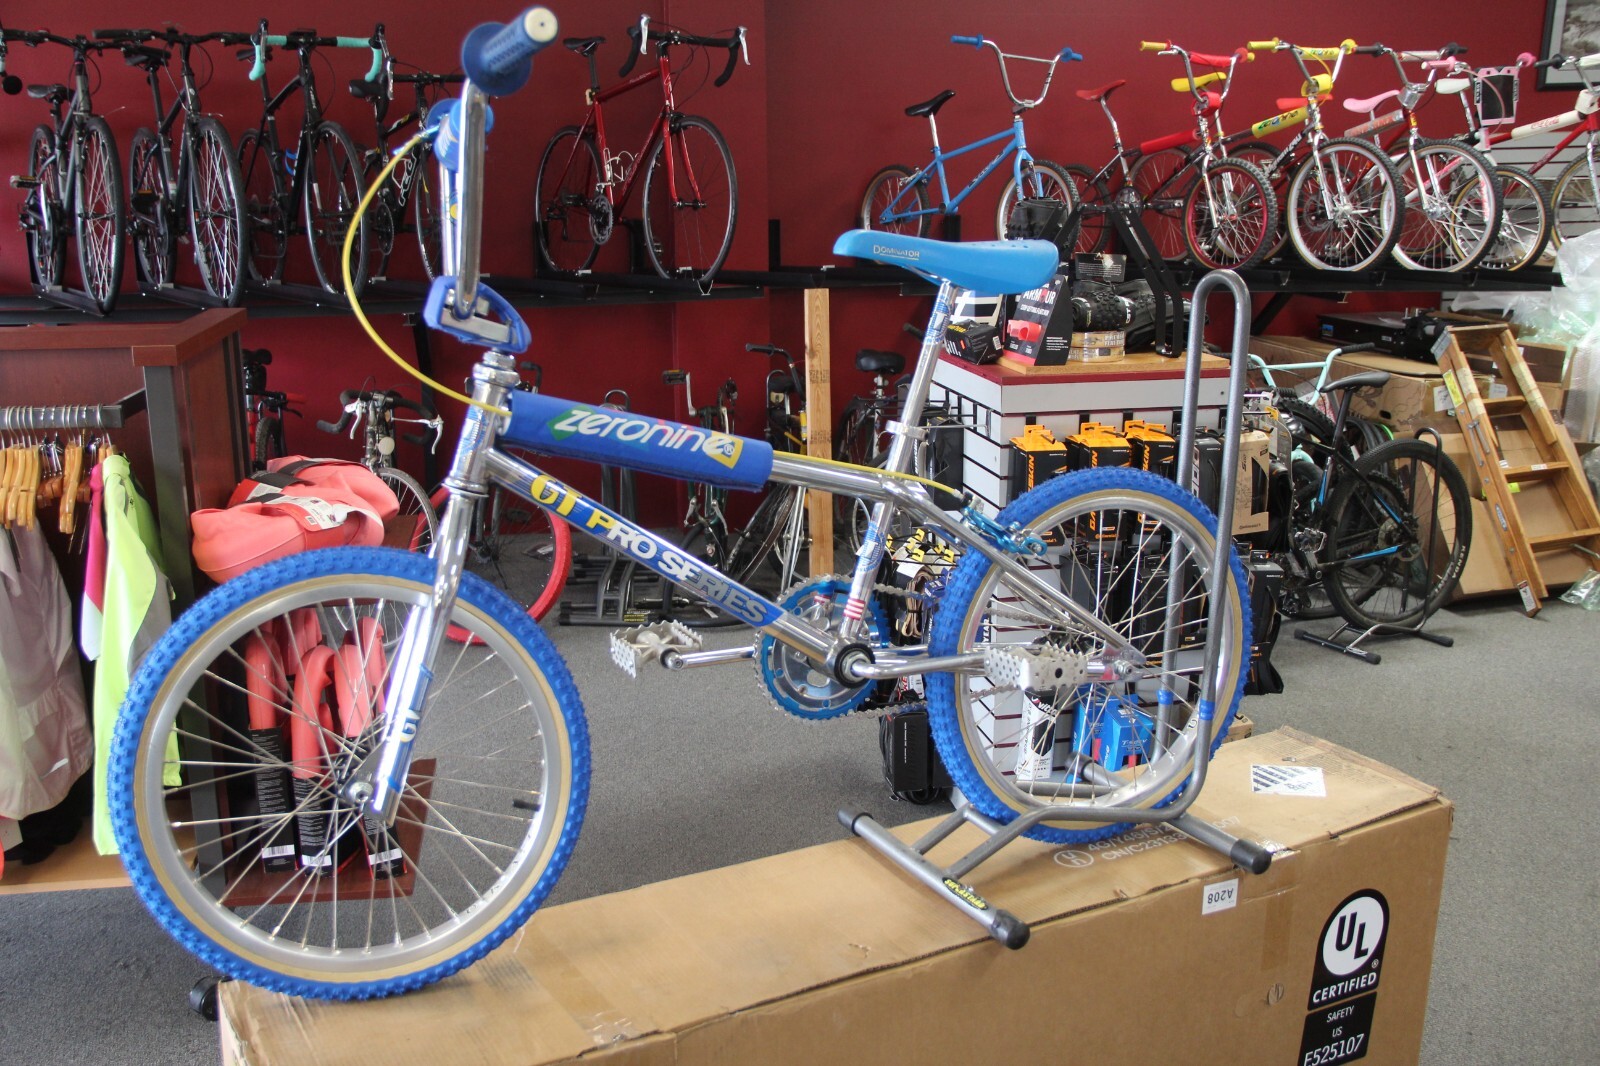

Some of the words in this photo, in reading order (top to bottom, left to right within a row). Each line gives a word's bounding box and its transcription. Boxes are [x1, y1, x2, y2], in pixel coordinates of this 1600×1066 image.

[873, 244, 920, 258] DOMINATOR
[553, 408, 731, 456] zeronine
[530, 474, 583, 517] GT
[586, 508, 658, 560] PRO
[658, 552, 768, 623] SERIES
[1451, 545, 1466, 578] KENDA
[1207, 887, 1234, 904] A208
[1335, 912, 1369, 960] UL
[1312, 972, 1377, 1003] CERTIFIED
[1326, 1005, 1355, 1023] SAFETY
[1331, 1025, 1343, 1038] US
[1303, 1033, 1365, 1066] E525107
